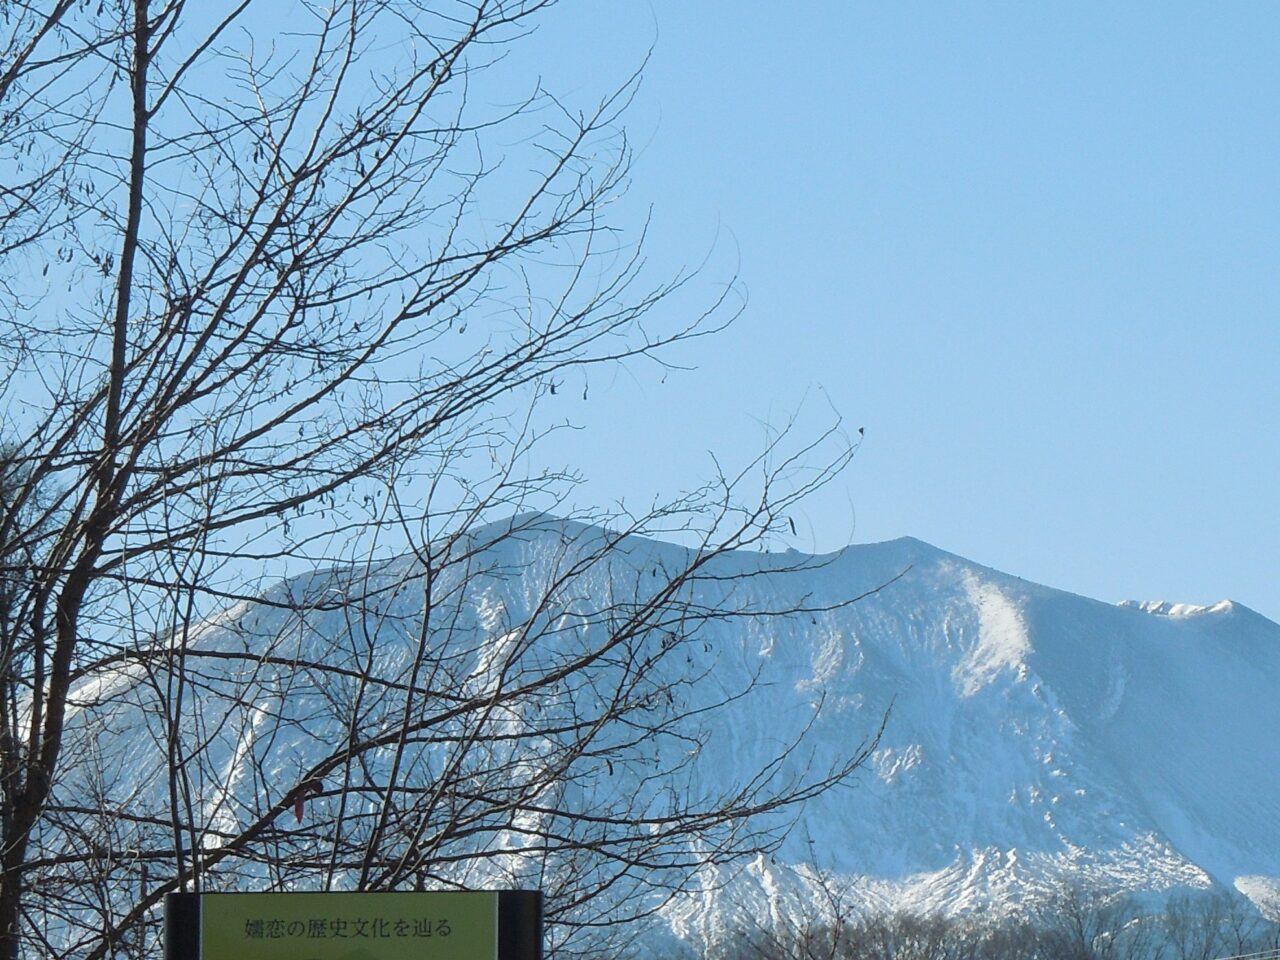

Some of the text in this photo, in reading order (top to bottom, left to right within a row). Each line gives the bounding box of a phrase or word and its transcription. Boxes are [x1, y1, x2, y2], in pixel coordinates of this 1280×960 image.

[244, 918, 452, 939] 嬬恋の歴史文化を辿る
